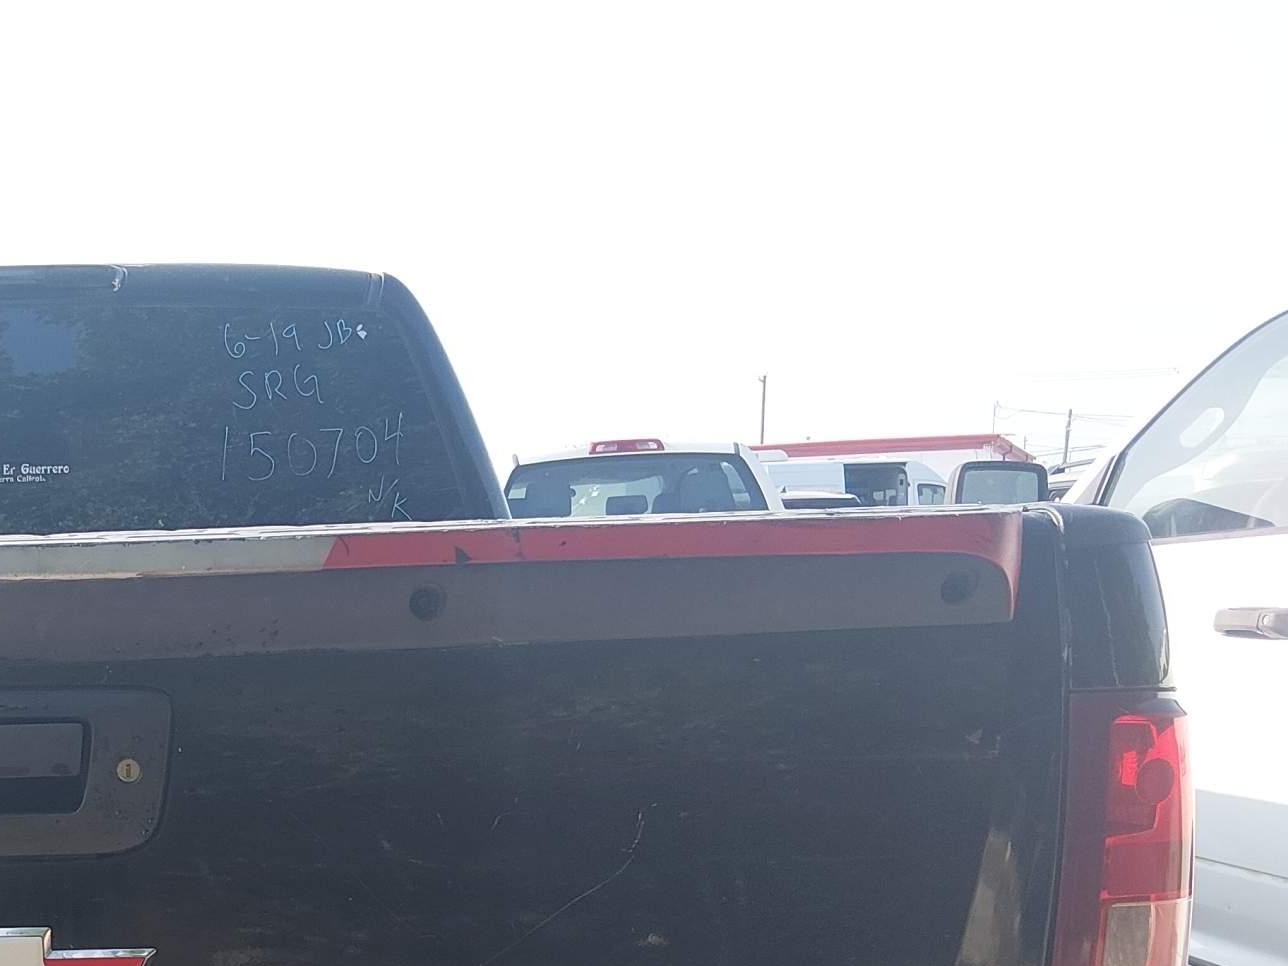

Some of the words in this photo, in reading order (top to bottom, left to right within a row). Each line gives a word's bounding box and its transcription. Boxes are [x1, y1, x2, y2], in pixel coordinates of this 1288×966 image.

[224, 322, 303, 358] 6-19
[222, 412, 404, 481] 150704
[21, 463, 70, 475] Guerrero
